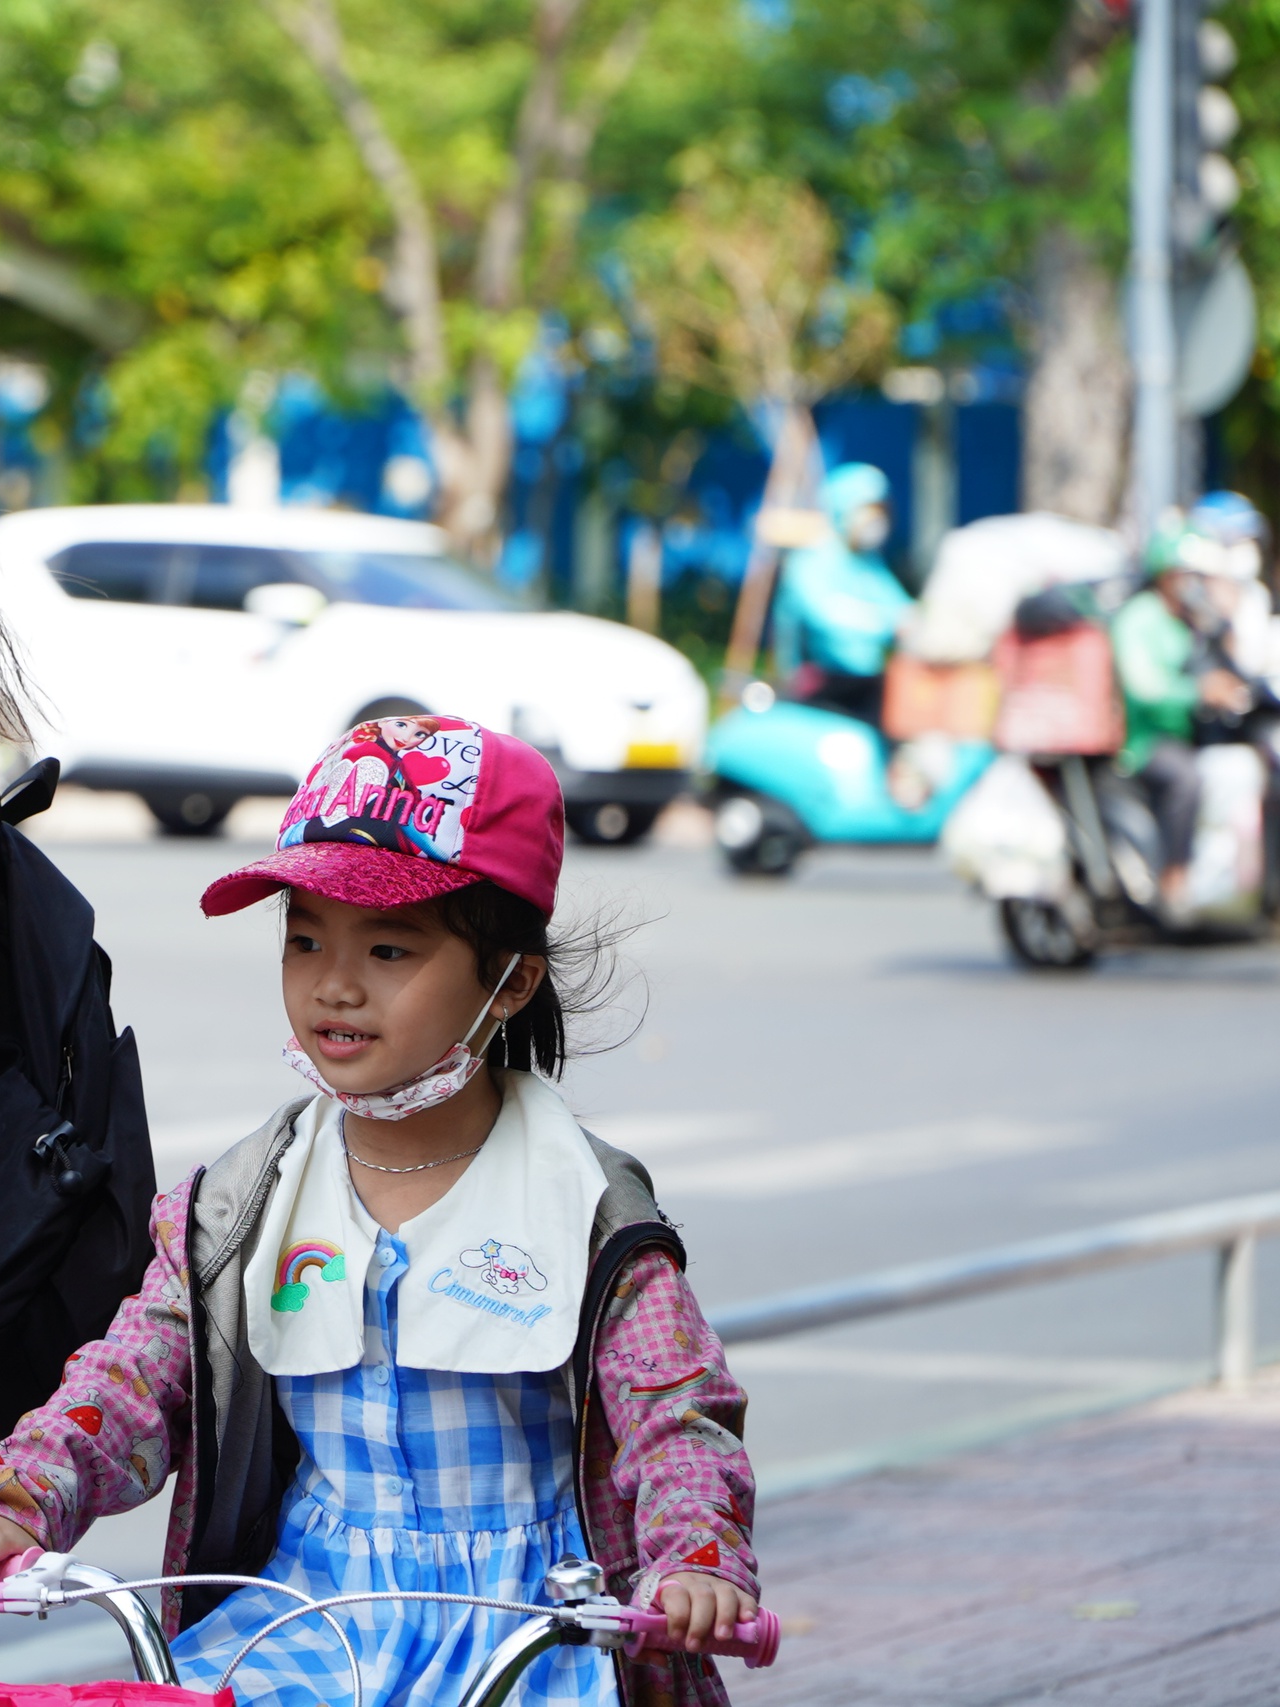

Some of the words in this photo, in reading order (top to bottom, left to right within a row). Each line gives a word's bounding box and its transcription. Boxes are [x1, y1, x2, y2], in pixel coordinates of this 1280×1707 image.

[417, 735, 480, 764] ove
[325, 764, 446, 836] Anna
[428, 1267, 552, 1328] Cinnamoroll
